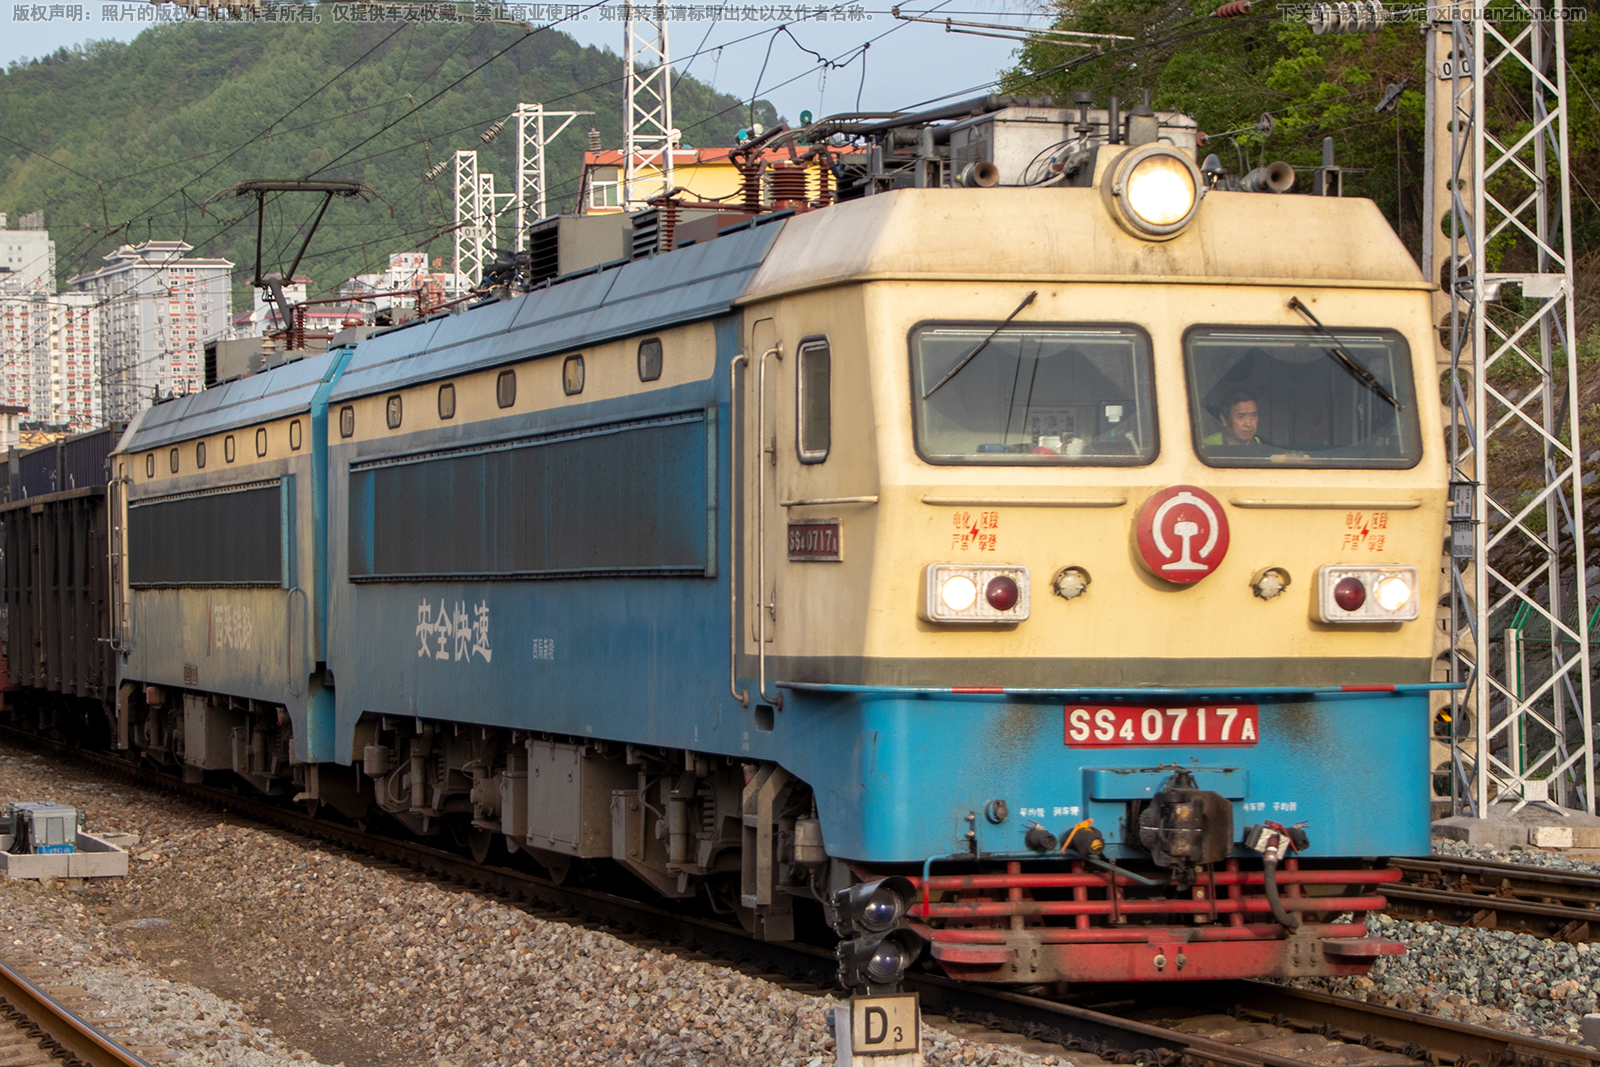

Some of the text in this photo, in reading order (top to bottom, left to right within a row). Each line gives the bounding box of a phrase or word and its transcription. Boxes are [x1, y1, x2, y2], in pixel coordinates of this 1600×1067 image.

[1443, 60, 1470, 76] 00
[465, 228, 482, 237] 011
[415, 597, 492, 663] 安全快速
[1069, 708, 1256, 741] SS40717A
